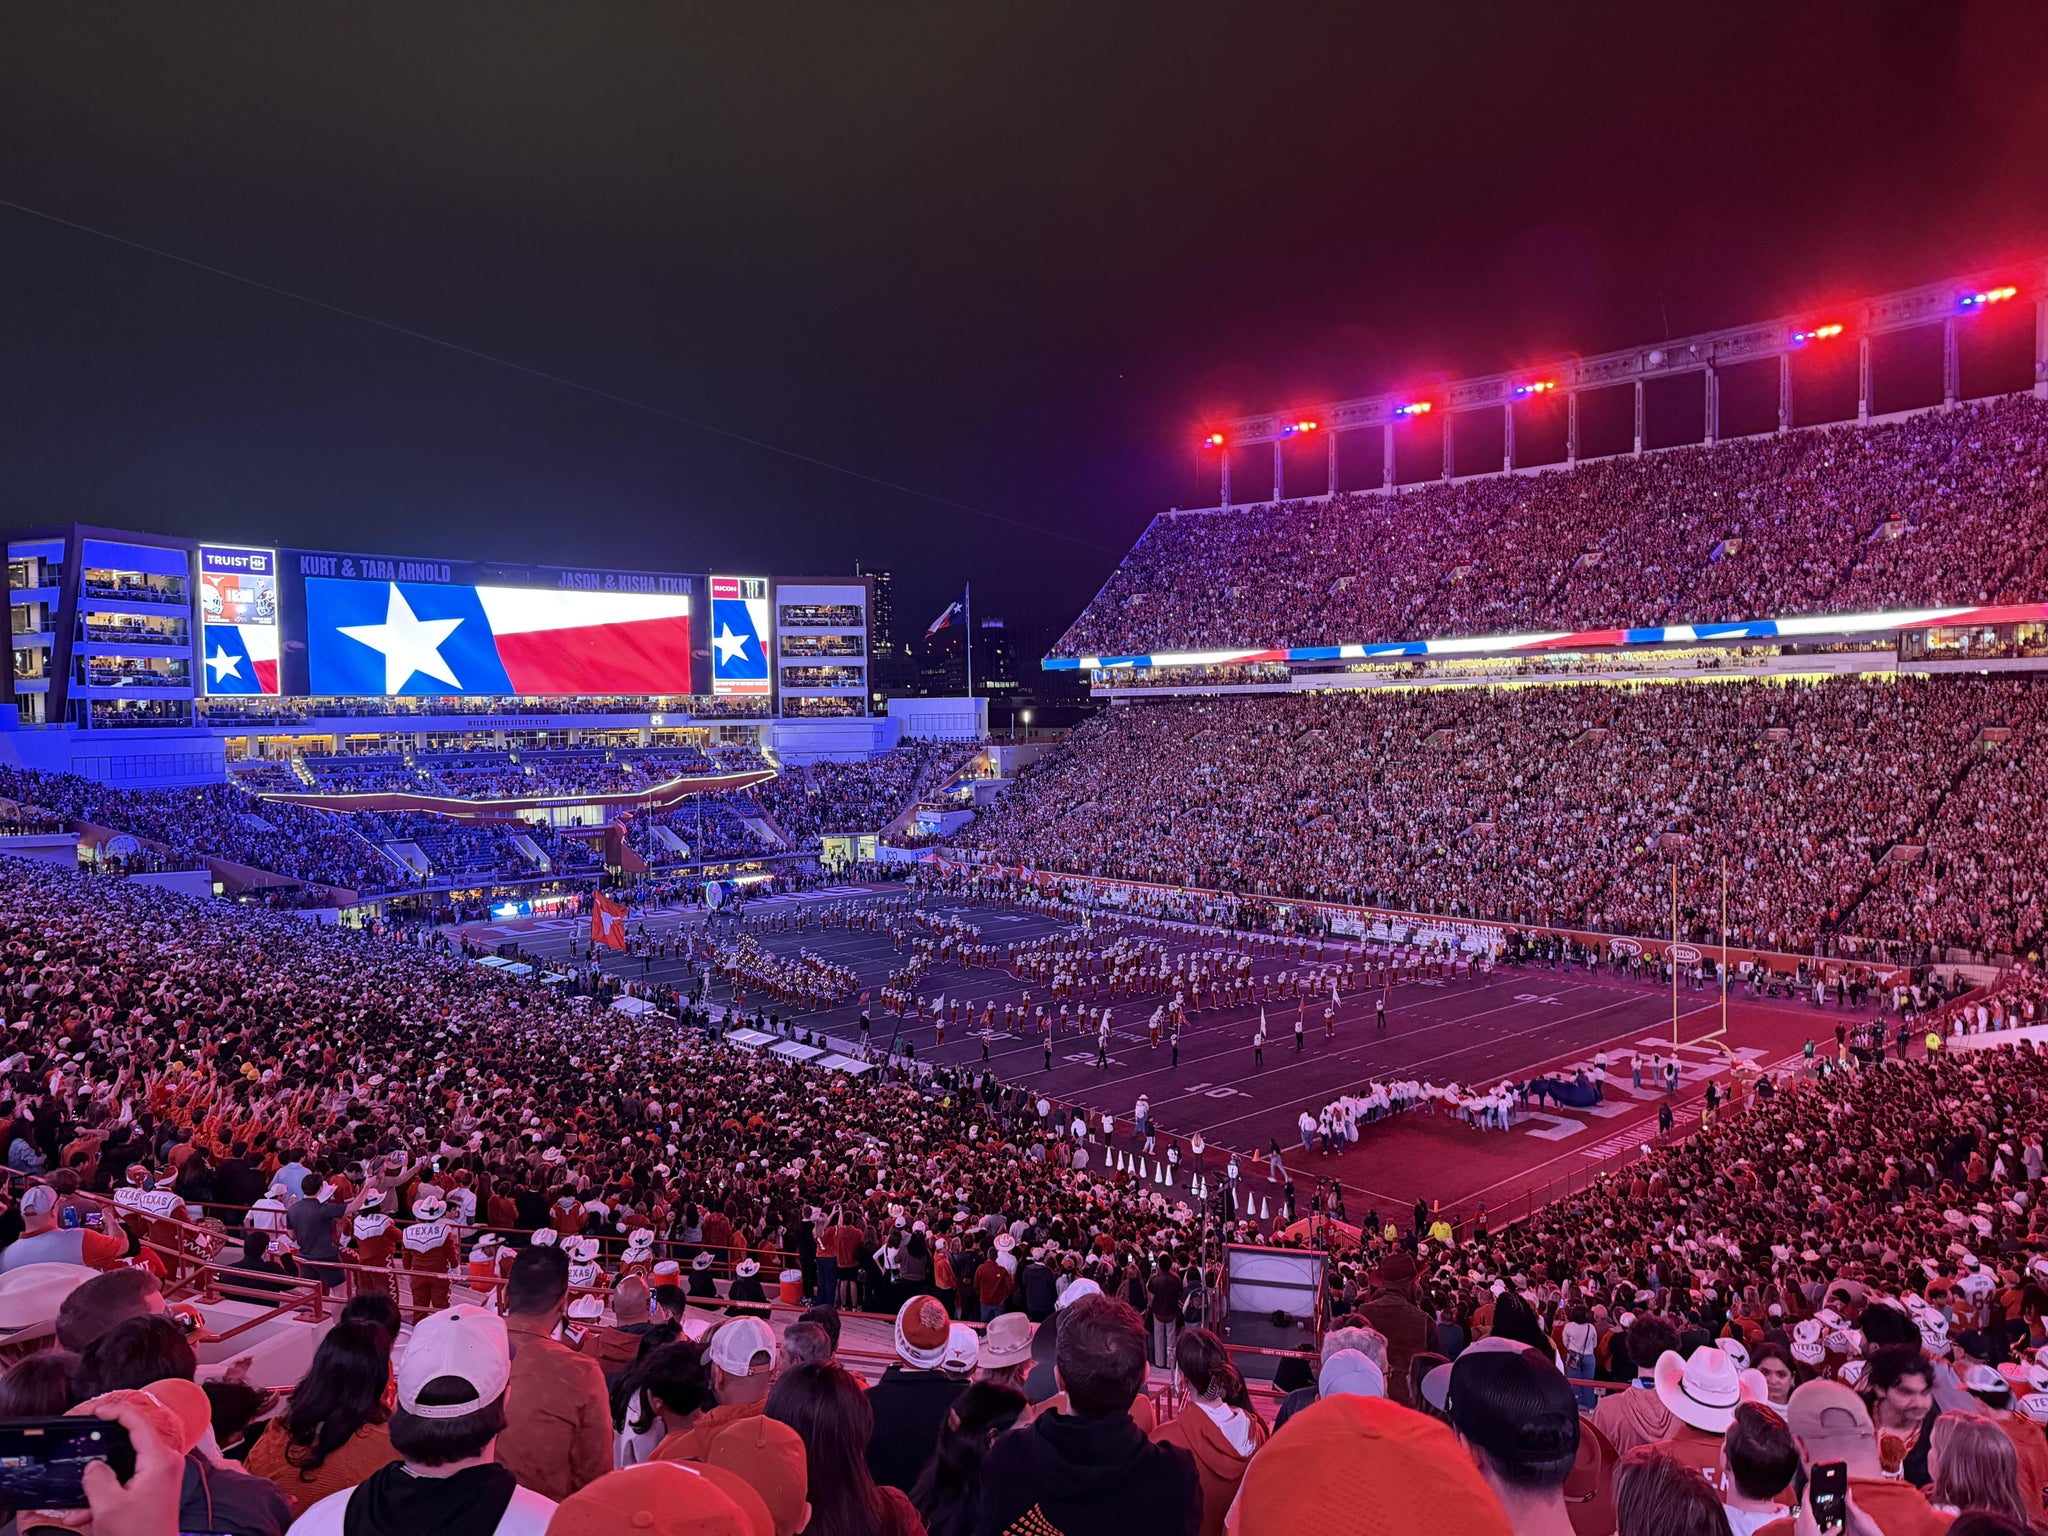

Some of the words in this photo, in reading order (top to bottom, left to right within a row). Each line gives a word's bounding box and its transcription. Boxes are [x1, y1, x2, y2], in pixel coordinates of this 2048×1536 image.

[206, 554, 248, 567] TRUIST
[300, 555, 337, 576] KURT
[341, 558, 356, 577] &
[360, 559, 396, 580] TARA
[398, 562, 450, 582] ARNOLD
[558, 571, 600, 590] JASON
[604, 574, 617, 591] &
[618, 575, 656, 593] KISHA
[659, 577, 692, 594] ITKIN
[1347, 910, 1360, 922] OF
[1184, 1082, 1239, 1098] 10
[143, 1194, 168, 1206] TEXAS
[410, 1226, 440, 1236] TEXAS
[568, 1268, 590, 1277] EXAS
[1972, 1289, 1994, 1311] 64
[1796, 1343, 1820, 1353] TEXAS
